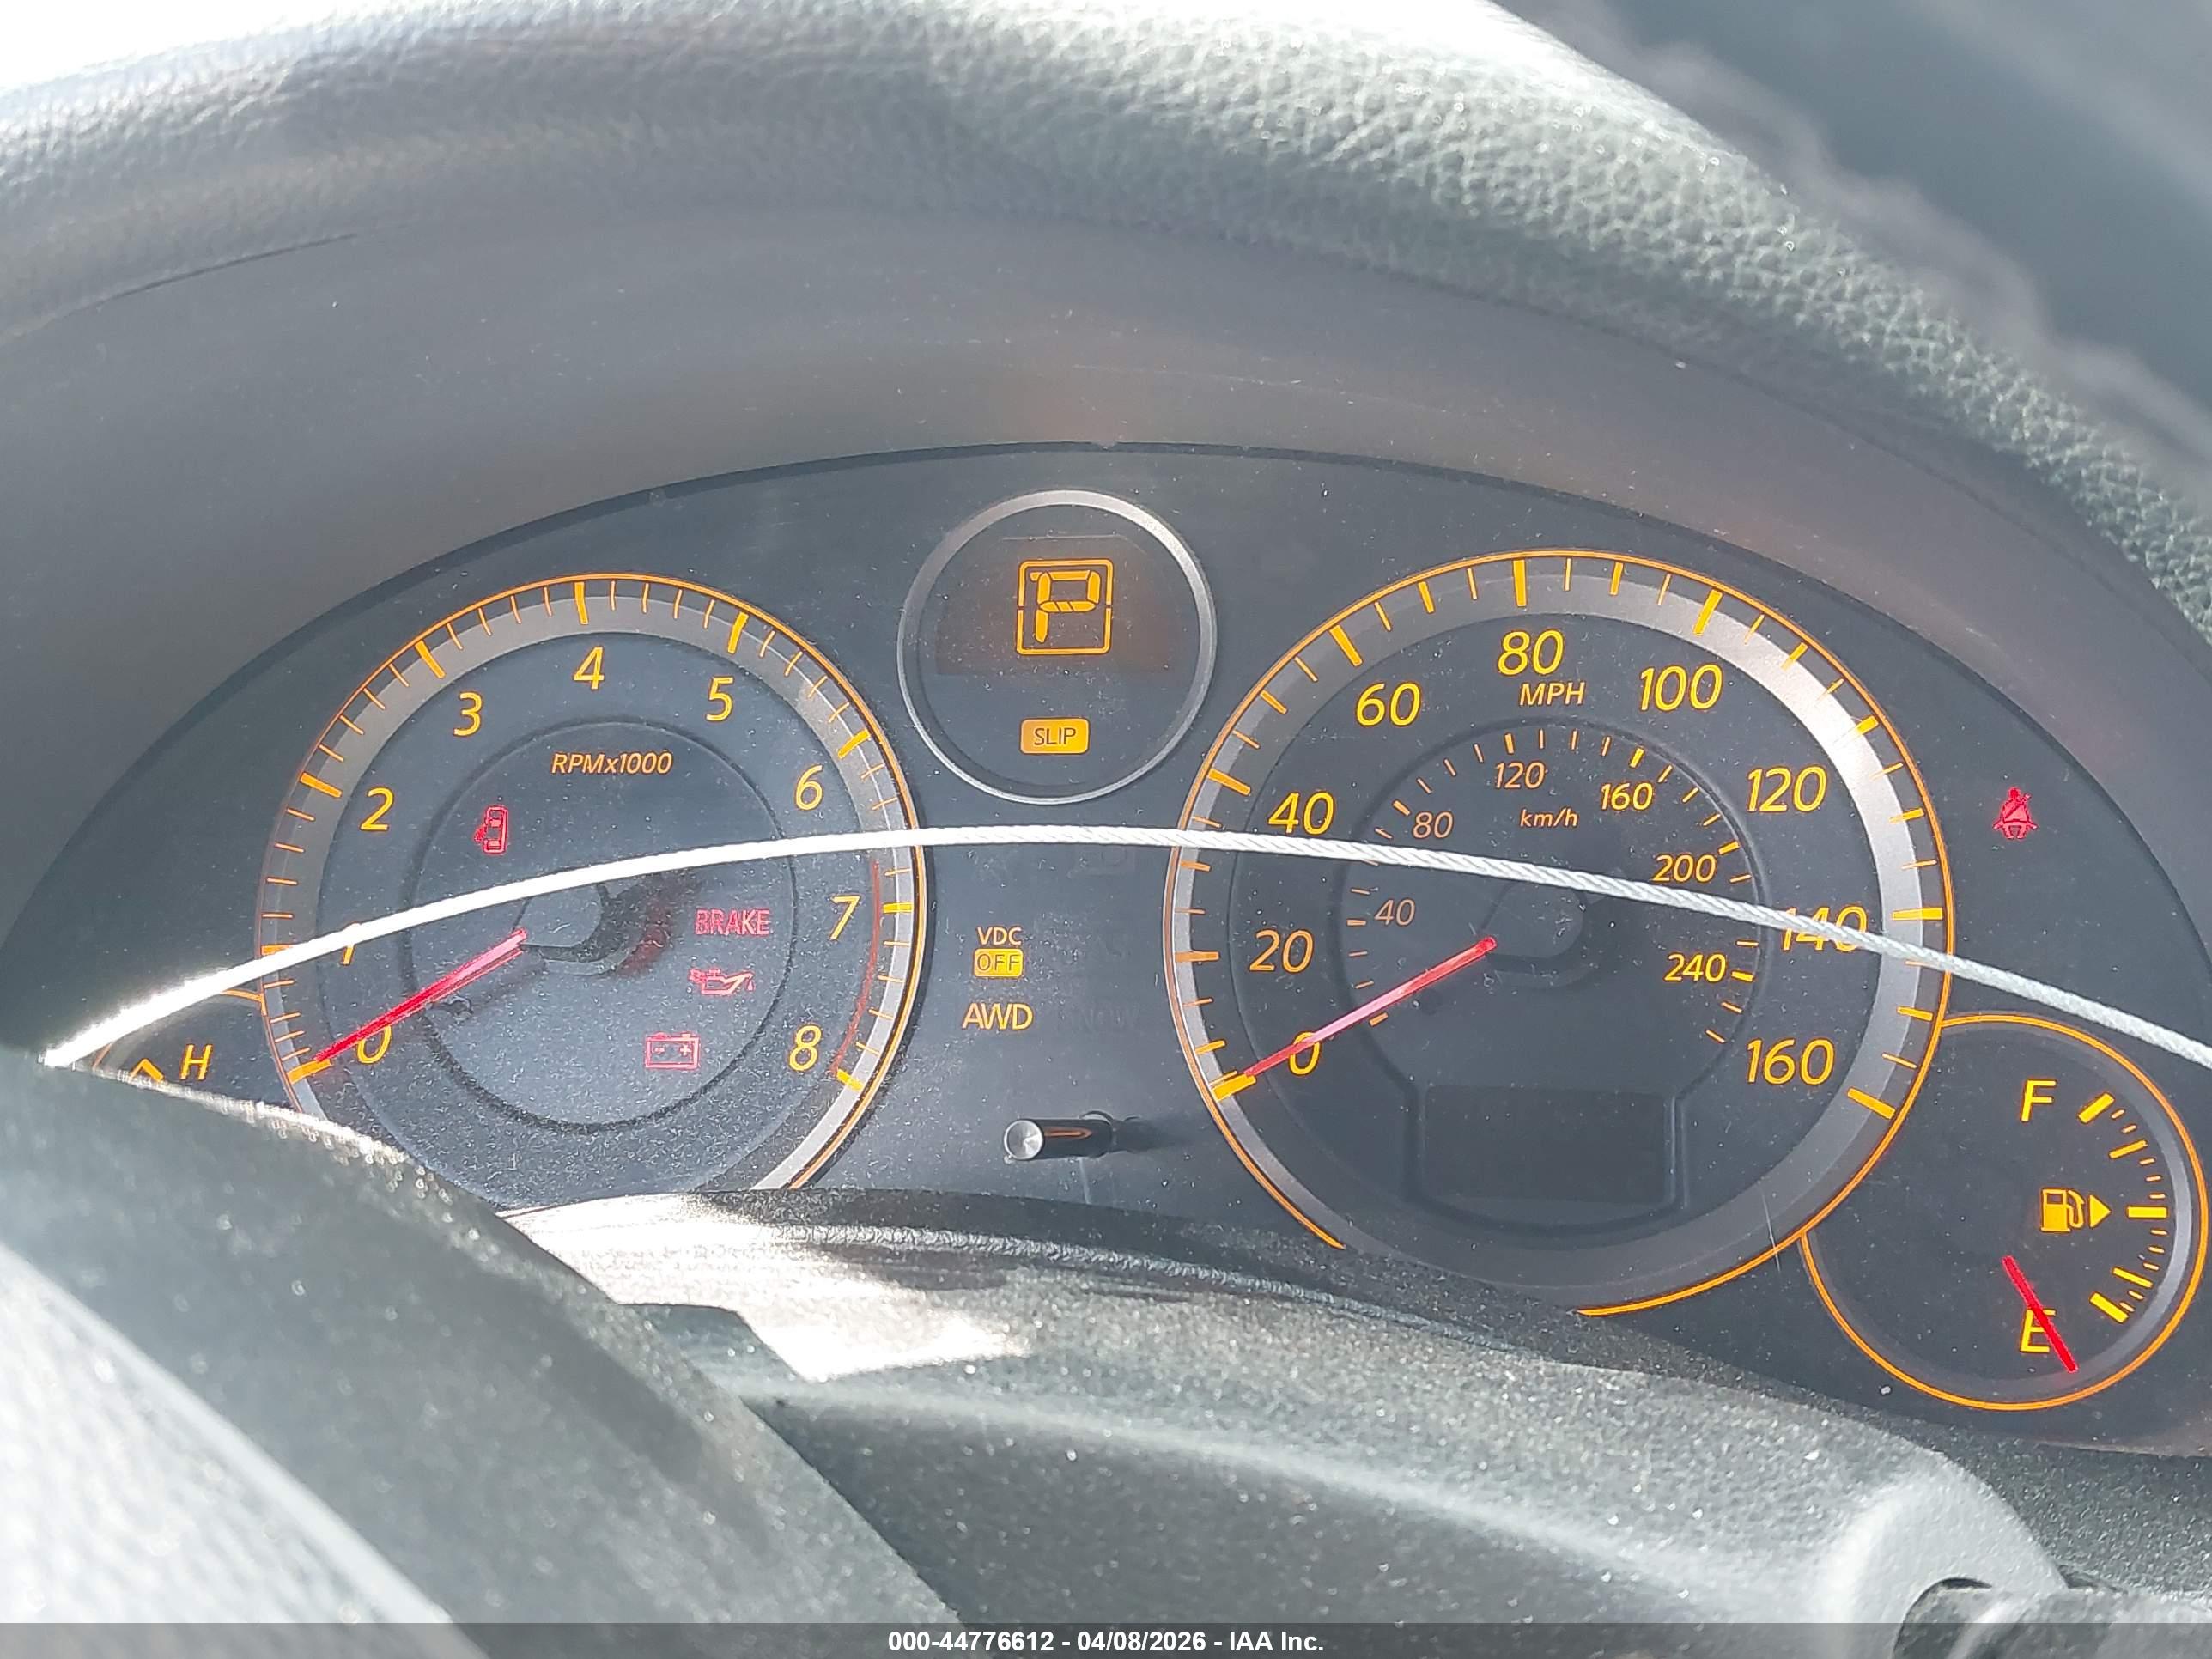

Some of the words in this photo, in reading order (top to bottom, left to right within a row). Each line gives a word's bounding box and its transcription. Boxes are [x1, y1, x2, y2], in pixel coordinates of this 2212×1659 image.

[1029, 568, 1103, 644] P
[572, 646, 605, 690] 4
[1497, 628, 1565, 677] 80
[706, 675, 734, 722] 5
[1354, 681, 1422, 728] 60
[1518, 681, 1586, 707] MPH
[1639, 662, 1723, 712] 100
[453, 690, 484, 738] 3
[1033, 726, 1078, 745] SLIP
[551, 750, 674, 775] RPMx1000
[1495, 761, 1545, 790] 120
[359, 786, 397, 832] 2
[793, 765, 823, 811] 6
[1600, 781, 1654, 811] 160
[1747, 764, 1827, 813] 120
[1267, 790, 1336, 836] 40
[1412, 811, 1455, 840] 80
[1519, 807, 1580, 829] km/h
[1651, 853, 1717, 885] 200
[695, 908, 770, 936] BRAKE
[830, 895, 860, 939] 7
[1375, 898, 1416, 927] 40
[976, 926, 1023, 946] VDC
[1249, 928, 1315, 974] 20
[975, 952, 1021, 973] OFF
[1662, 951, 1727, 984] 240
[961, 1002, 1035, 1031] AWD
[179, 1042, 214, 1081] H
[356, 1019, 393, 1065] 0
[787, 1025, 823, 1072] 8
[1288, 1031, 1321, 1075] 0
[1746, 1037, 1835, 1086] 160
[2019, 1077, 2057, 1122] F
[2018, 1307, 2057, 1354] E
